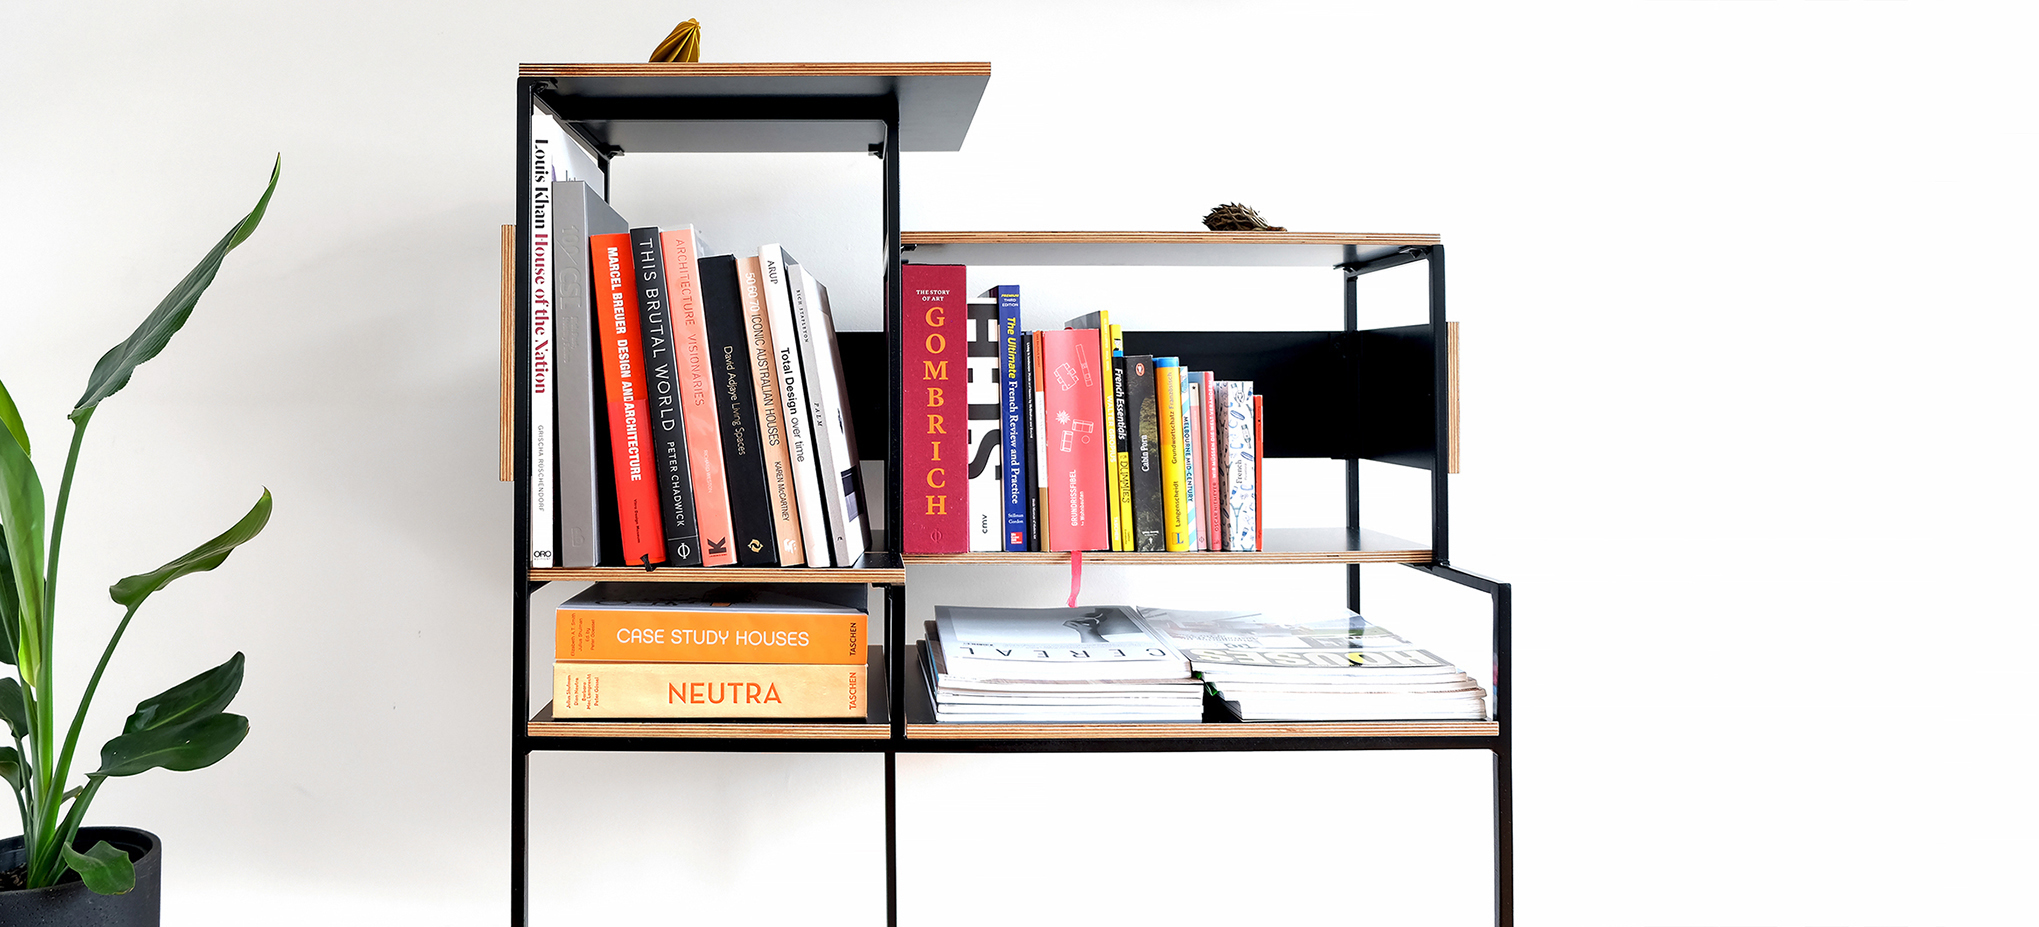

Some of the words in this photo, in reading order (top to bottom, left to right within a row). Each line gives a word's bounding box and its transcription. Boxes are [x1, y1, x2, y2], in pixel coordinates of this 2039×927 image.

[534, 139, 550, 183] Louis
[534, 187, 550, 229] Khan
[534, 234, 550, 285] House
[607, 247, 622, 291] MARCEL
[639, 238, 657, 281] THIS
[767, 259, 778, 285] ARUP
[744, 272, 756, 284] 50
[746, 285, 758, 298] 60
[534, 289, 550, 305] of
[612, 293, 627, 334] BREUER
[748, 300, 760, 312] 70
[534, 310, 550, 335] the
[646, 289, 666, 359] BRUTAL
[675, 239, 696, 326] ARCHITECTURE
[687, 333, 705, 407] VISIONARIES
[751, 314, 764, 347] ICONIC
[1007, 317, 1017, 335] The
[534, 339, 550, 394] Nation
[617, 340, 632, 378] DESIGN
[723, 345, 736, 371] David
[780, 347, 793, 374] Total
[1007, 337, 1018, 379] Ultimate
[621, 381, 634, 402] AND
[725, 372, 739, 401] Adjaye
[755, 347, 774, 406] AUSTRALIAN
[1114, 368, 1123, 397] French
[654, 363, 675, 431] WORLD
[785, 377, 798, 414] Design
[923, 306, 949, 516] GOMBRICH
[1008, 380, 1019, 413] French
[1106, 395, 1115, 427] WALTER
[730, 402, 741, 426] Living
[765, 409, 780, 446] HOUSES
[790, 417, 802, 438] over
[814, 402, 823, 427] PALM
[1009, 414, 1019, 447] Review
[1116, 398, 1126, 440] Essentials
[624, 403, 642, 481] ARCHITECTURE
[733, 426, 747, 456] Spaces
[794, 440, 806, 463] time
[1108, 428, 1116, 463] GROPIUS
[1139, 435, 1148, 451] Porn
[1169, 411, 1178, 465] Grundwortschatz
[1183, 416, 1191, 456] MELBOURNE
[666, 441, 678, 472] PETER
[774, 460, 785, 483] KAREN
[1010, 449, 1020, 466] and
[1141, 452, 1150, 472] Cabin
[1235, 459, 1243, 483] French
[537, 459, 545, 512] RÜSCHENDORF
[1011, 467, 1021, 504] Practice
[1119, 460, 1131, 504] DUMMIES
[1185, 457, 1194, 502] MID-CENTURY
[671, 474, 685, 527] CHADWICK
[1069, 469, 1078, 527] GRUNDRISSFIBEL
[1173, 481, 1181, 528] Langenscheidt
[980, 513, 988, 535] cmv
[534, 550, 551, 558] ORO
[706, 536, 727, 555] K
[616, 627, 664, 645] CASE
[670, 628, 729, 646] STUDY
[735, 629, 810, 647] HOUSES
[849, 622, 857, 656] TASCHEN
[959, 646, 1166, 659] CEREAL
[1189, 647, 1441, 668] HOUSES
[668, 681, 783, 705] NEUTRA
[848, 672, 857, 710] TASCHEN
